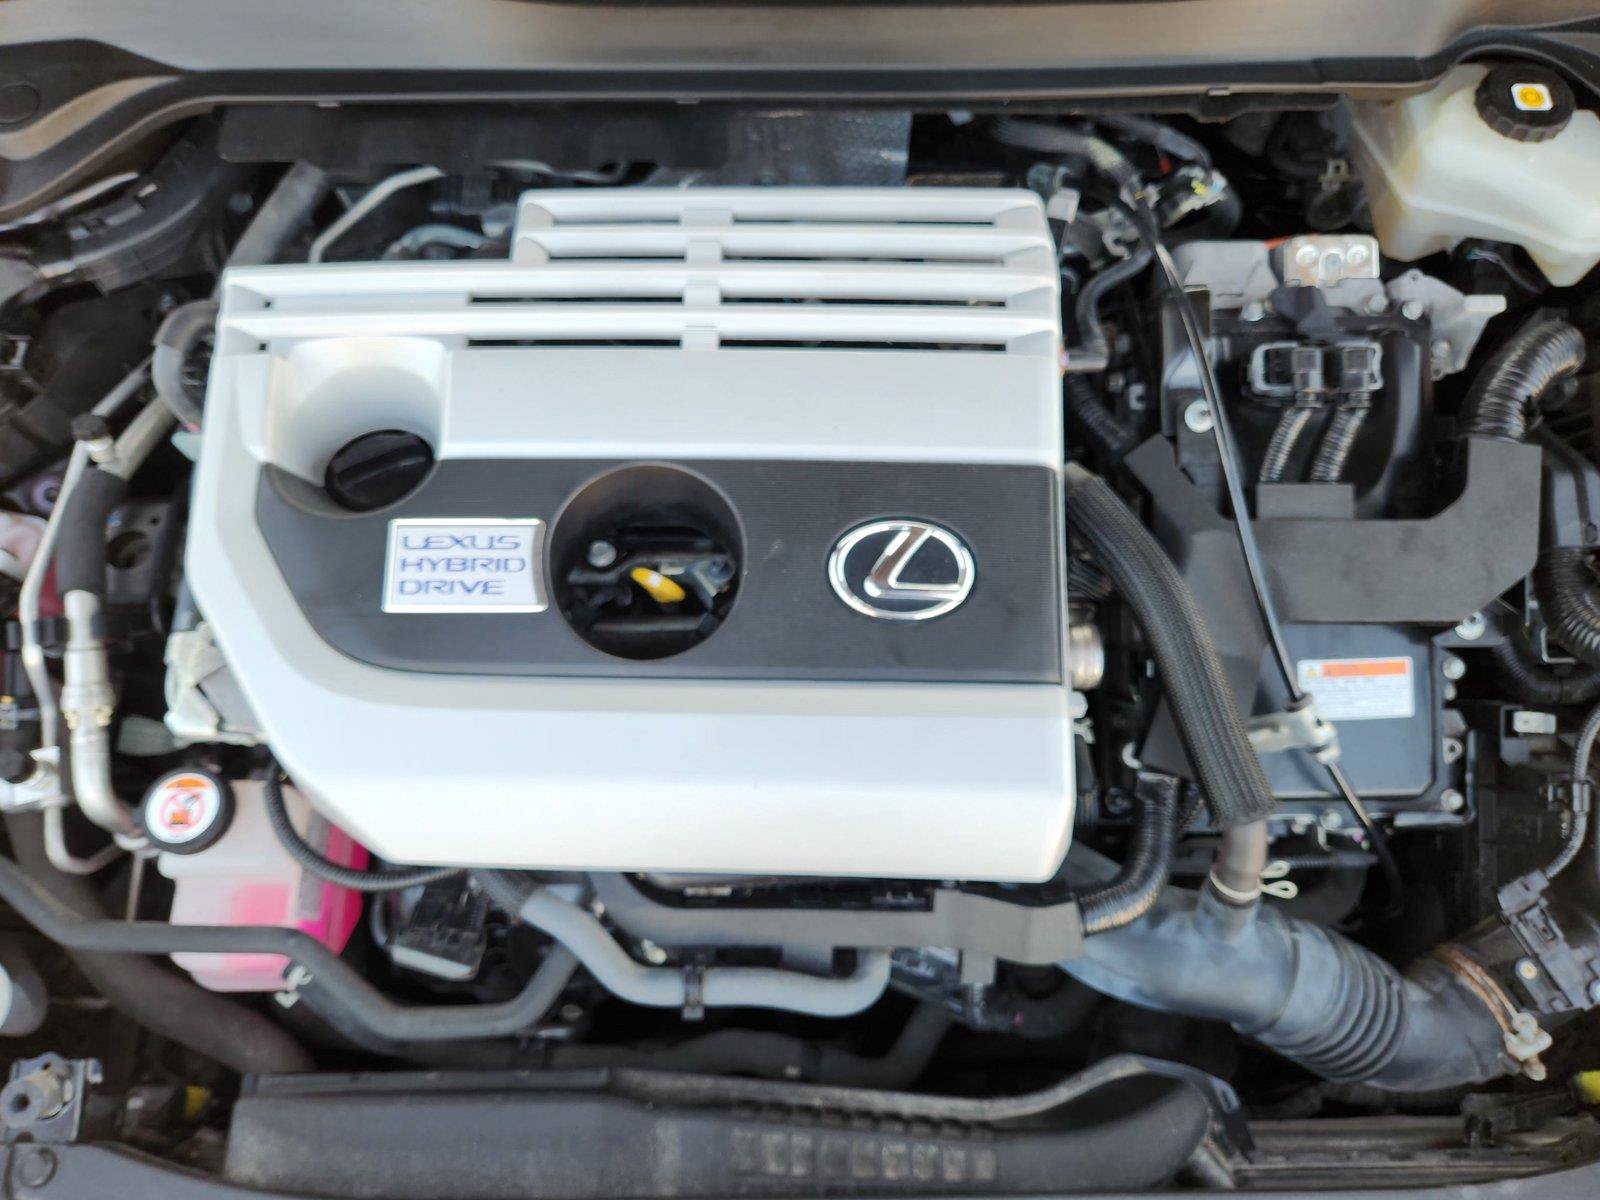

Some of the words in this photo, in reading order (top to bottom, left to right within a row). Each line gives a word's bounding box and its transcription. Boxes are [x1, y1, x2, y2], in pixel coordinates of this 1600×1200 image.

[402, 535, 521, 550] LEXUS
[400, 557, 527, 573] HYBRID
[400, 579, 506, 595] DRIVE
